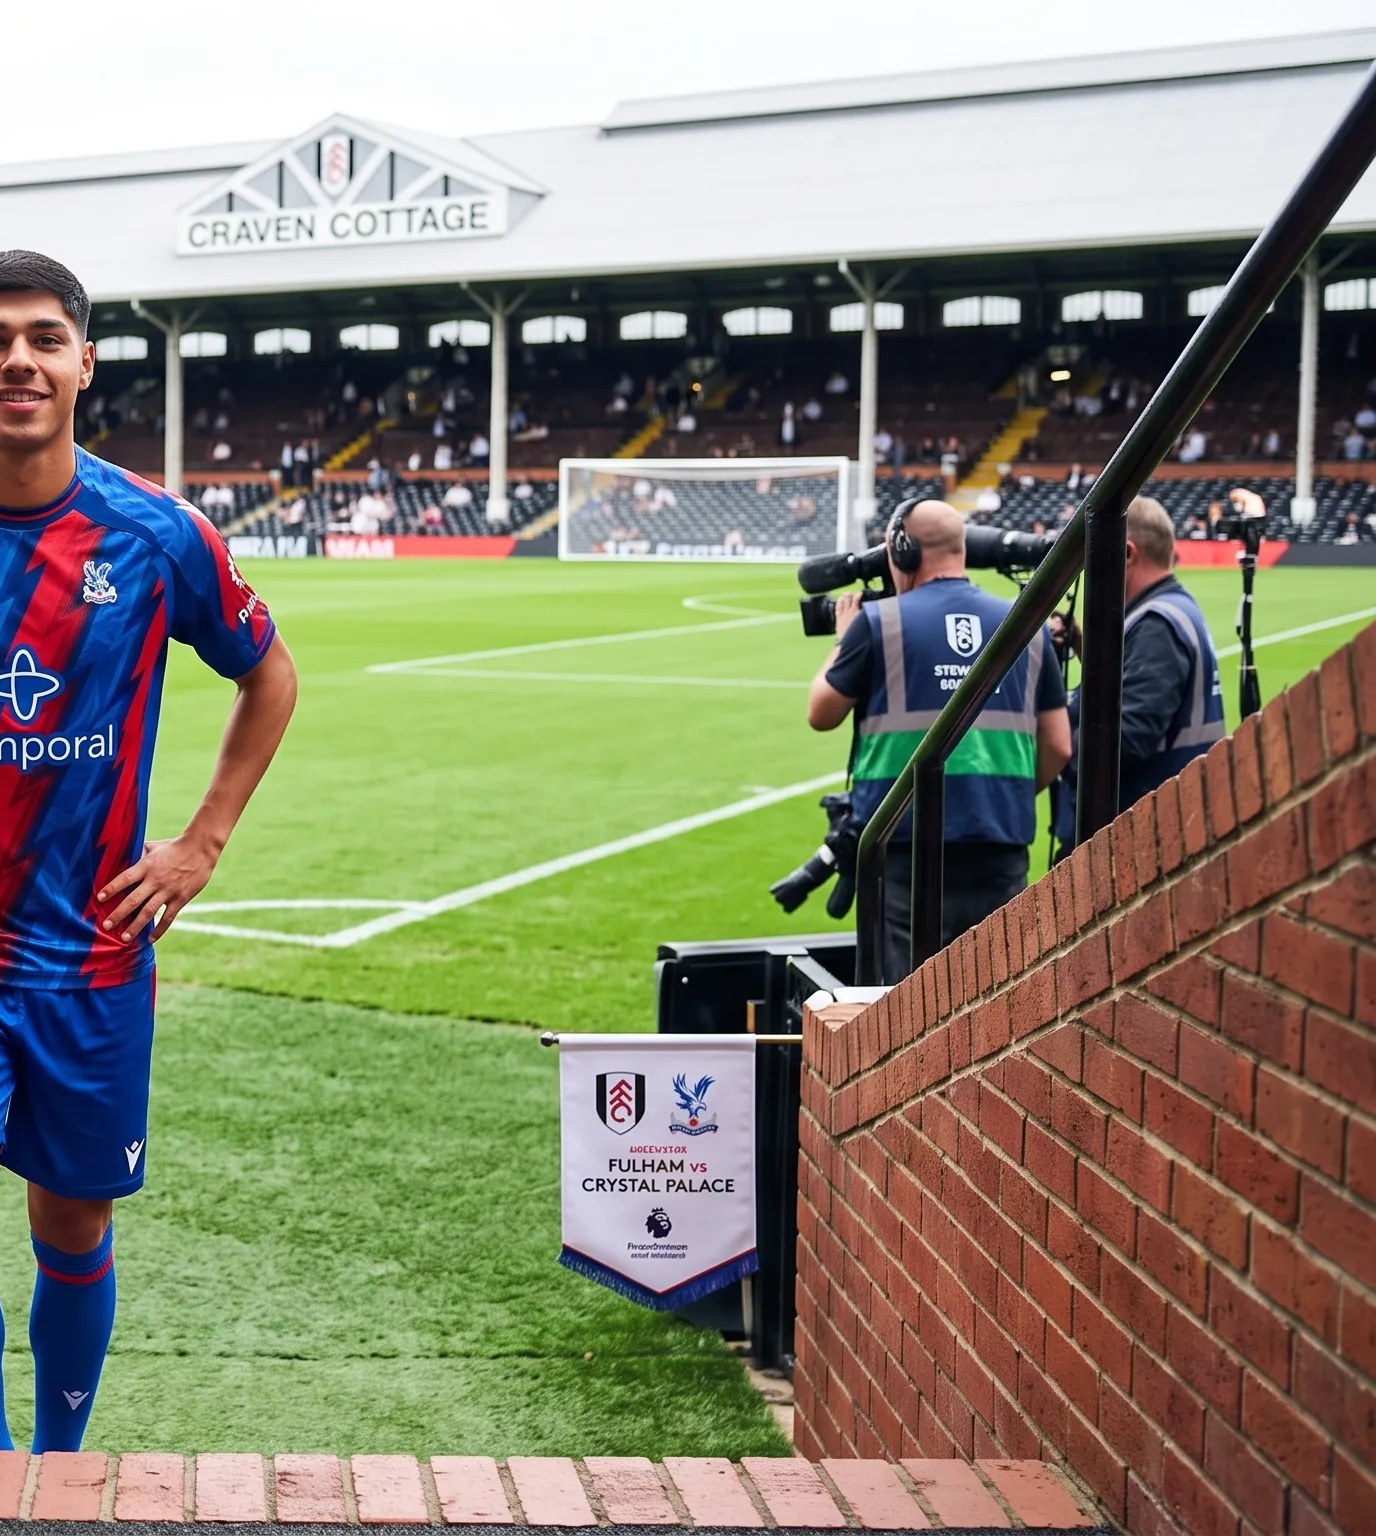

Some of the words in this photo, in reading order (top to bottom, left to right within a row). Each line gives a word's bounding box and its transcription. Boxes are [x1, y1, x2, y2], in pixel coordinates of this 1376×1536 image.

[188, 214, 315, 249] CRAVEN
[330, 201, 490, 239] COTTAGE
[608, 1158, 685, 1173] FULHAM
[581, 1178, 661, 1193] CRYSTAL
[666, 1178, 735, 1193] PALACE
